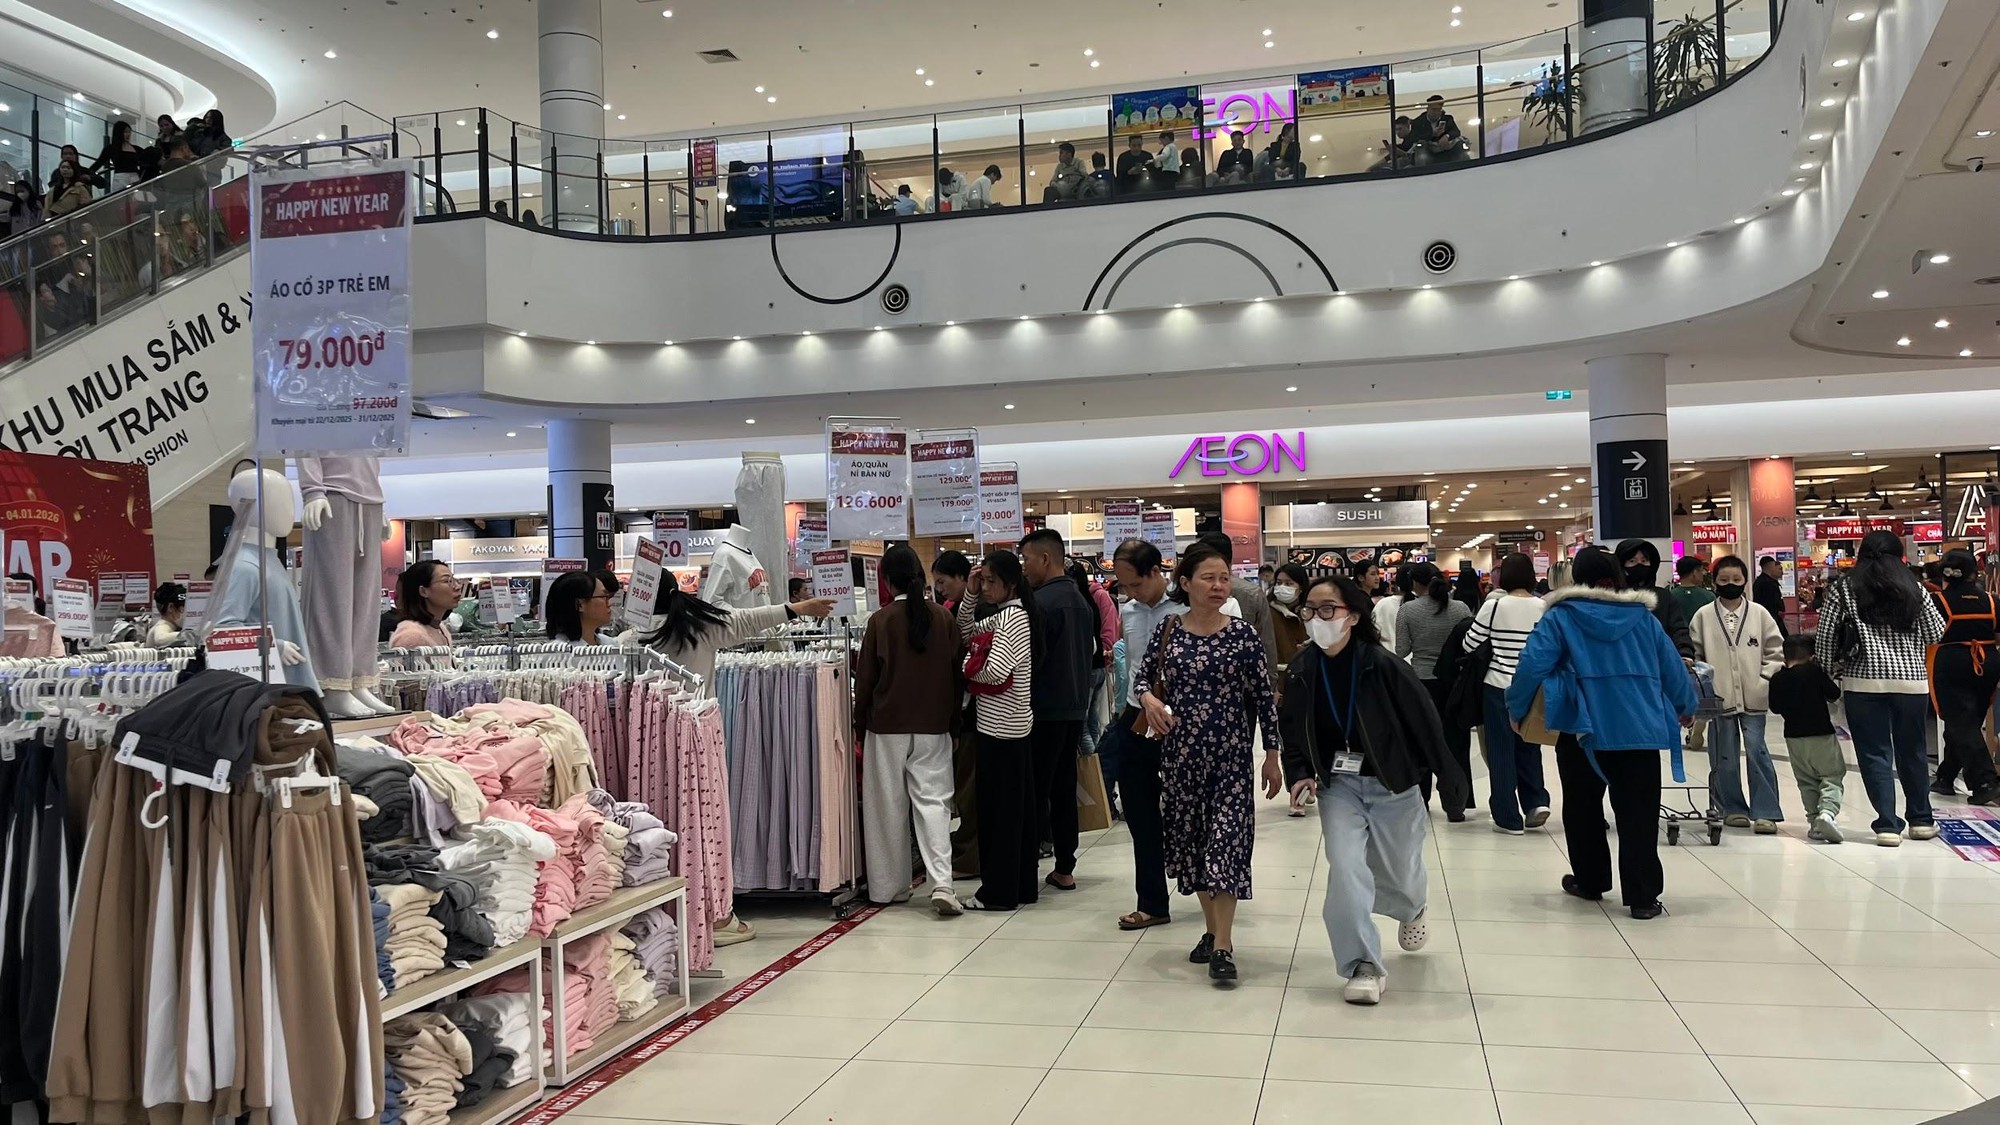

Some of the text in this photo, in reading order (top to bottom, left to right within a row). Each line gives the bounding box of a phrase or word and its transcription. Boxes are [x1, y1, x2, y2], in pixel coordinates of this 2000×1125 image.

[1193, 88, 1297, 140] EON
[276, 193, 389, 221] HAPPY NEW YEAR
[270, 273, 390, 299] ÁO CỔ 3P TRẺ EM
[279, 331, 385, 370] 79.000đ
[0, 396, 65, 453] HU
[66, 354, 149, 420] MUA
[147, 313, 216, 373] SẮM
[217, 302, 241, 335] &
[98, 370, 210, 454] TRANG
[358, 413, 395, 422] 31/12/2025
[129, 429, 190, 467] ASHION
[840, 439, 899, 449] HAPPY NEW YEAR
[917, 448, 936, 457] HAPPY
[837, 495, 903, 508] 126.600đ
[6, 508, 60, 523] 04.01.2026
[1337, 510, 1382, 521] SUSHI
[1827, 526, 1852, 535] HAPPY
[1853, 525, 1871, 534] NEW
[470, 544, 515, 556] TAKOYAK
[212, 636, 234, 646] HAPPY
[235, 635, 249, 644] NEW
